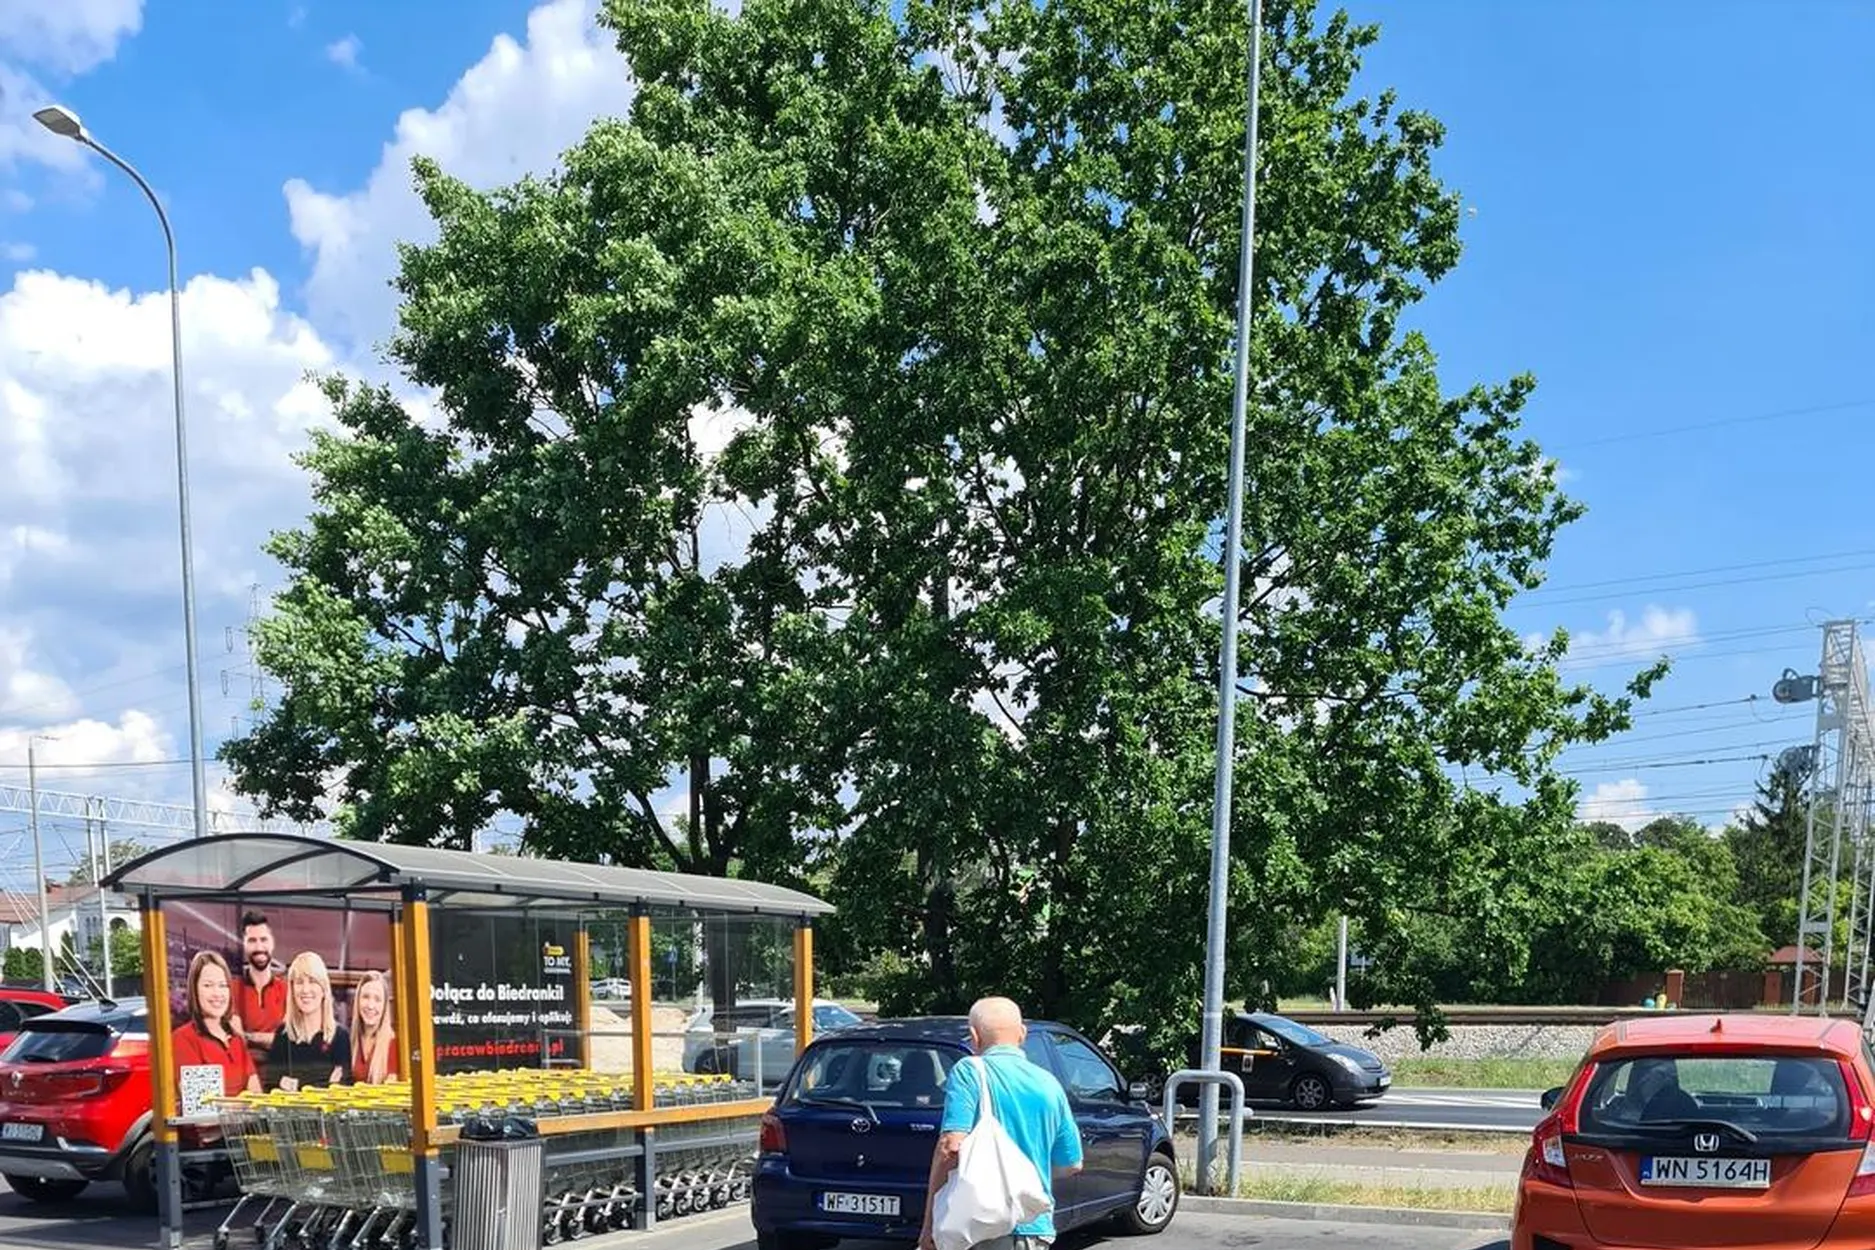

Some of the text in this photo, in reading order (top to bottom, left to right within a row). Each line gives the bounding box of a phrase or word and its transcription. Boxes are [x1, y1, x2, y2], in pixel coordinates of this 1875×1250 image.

[476, 982, 495, 1001] do
[497, 983, 564, 1001] Biedronki!
[467, 1014, 479, 1024] co
[482, 1011, 530, 1025] oferujemy
[532, 1012, 536, 1022] i
[1656, 1159, 1688, 1179] WN
[1696, 1160, 1768, 1181] 5164H
[827, 1194, 896, 1213] WF 3151T
